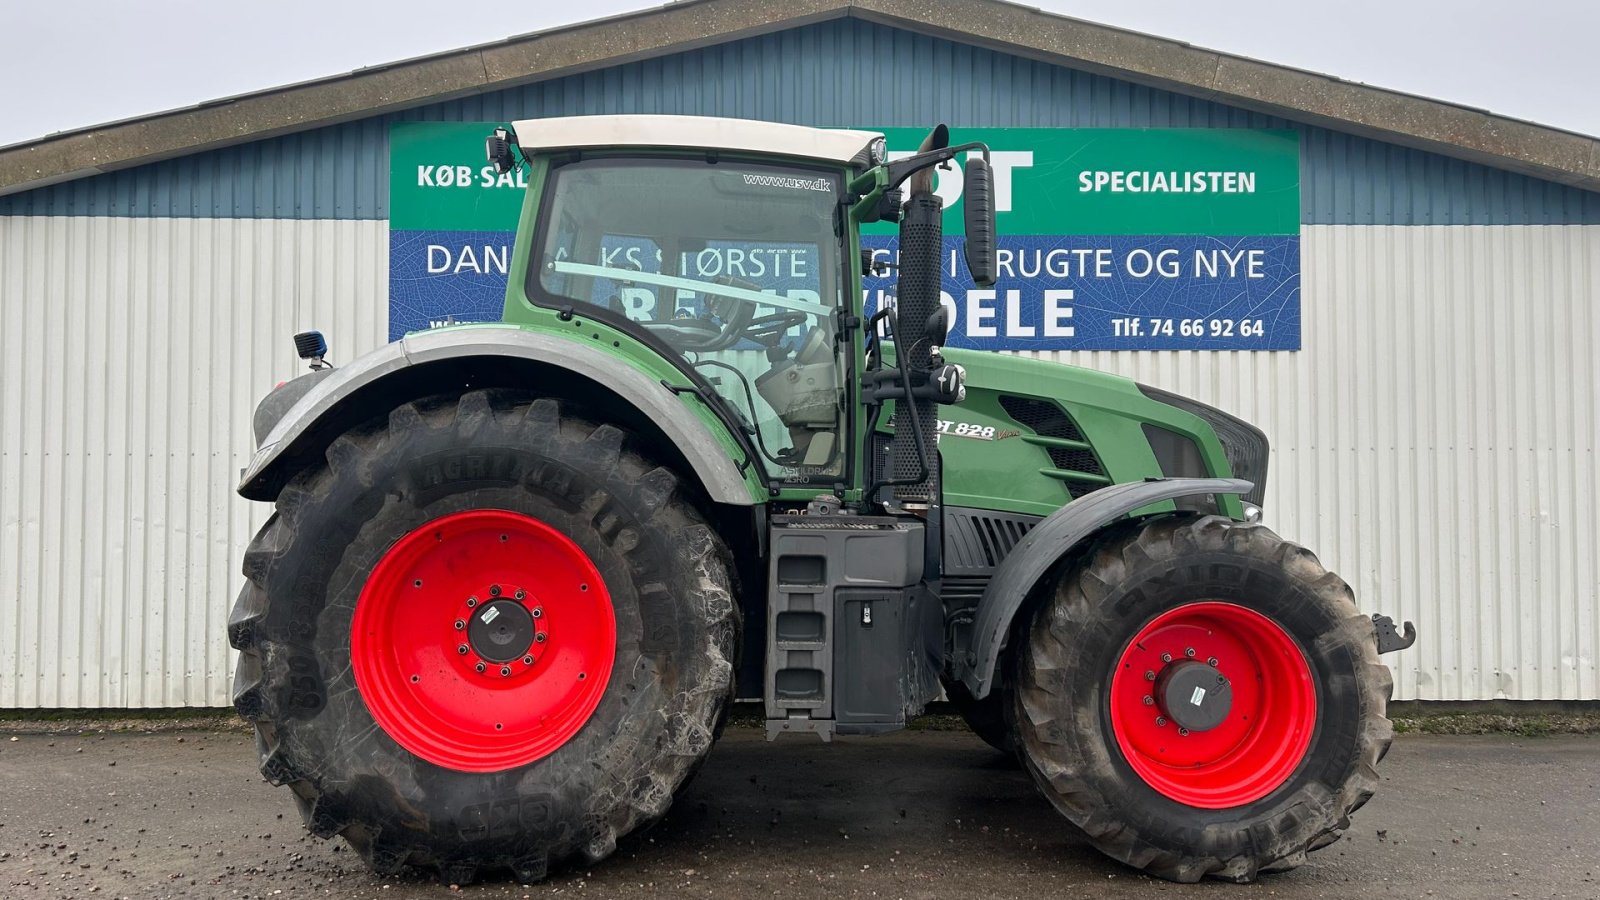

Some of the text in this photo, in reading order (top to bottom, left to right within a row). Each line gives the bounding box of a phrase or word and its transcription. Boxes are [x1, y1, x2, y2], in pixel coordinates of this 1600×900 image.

[417, 165, 1256, 193] KØB·SAL SPECIALISTEN
[743, 174, 831, 192] www.usv.dk
[996, 249, 1112, 278] RUGTE
[1126, 249, 1180, 278] OG
[1195, 249, 1265, 278] NYE
[1112, 318, 1264, 337] Tlf. 74 66 92 64
[955, 423, 995, 438] 828
